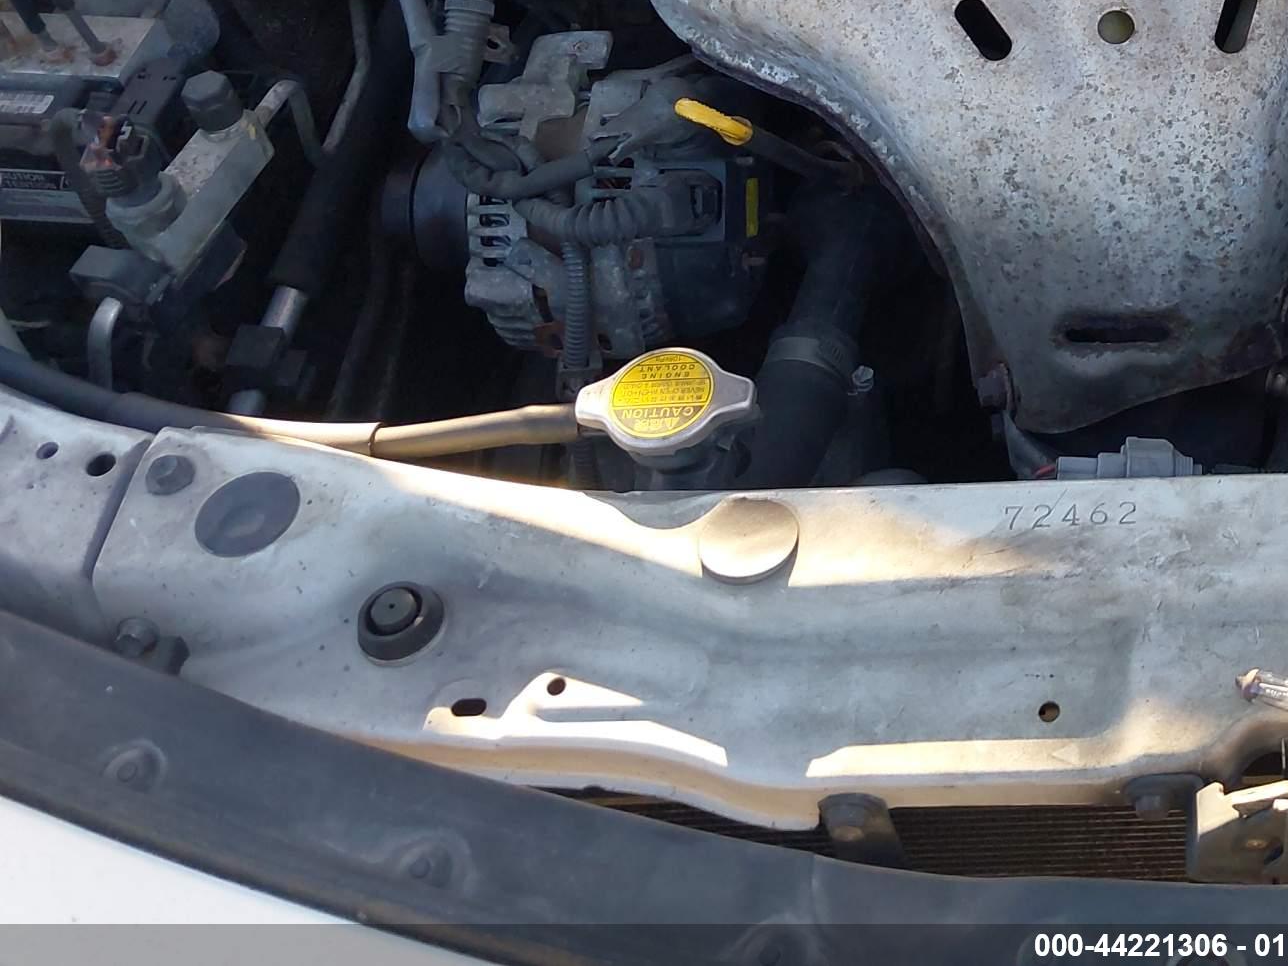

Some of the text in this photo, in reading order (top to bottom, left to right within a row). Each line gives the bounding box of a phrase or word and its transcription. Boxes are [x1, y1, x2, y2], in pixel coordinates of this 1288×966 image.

[639, 363, 696, 372] COOLANT
[640, 371, 690, 380] ENGINE
[622, 405, 694, 419] CAUTION
[1004, 501, 1137, 530] 72462
